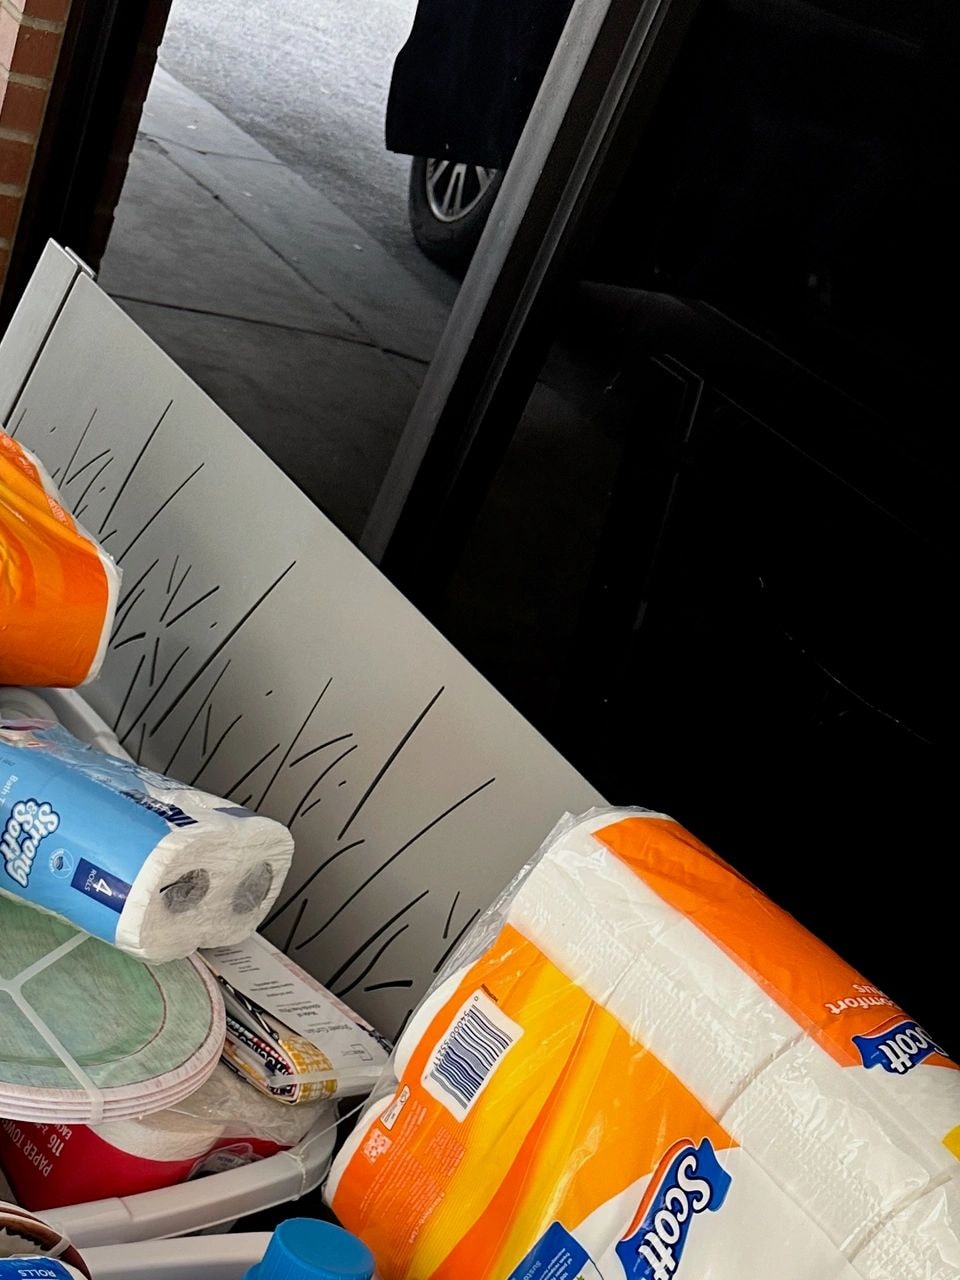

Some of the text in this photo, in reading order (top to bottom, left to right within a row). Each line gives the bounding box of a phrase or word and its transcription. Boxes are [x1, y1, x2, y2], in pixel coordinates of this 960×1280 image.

[0, 773, 19, 797] Bath
[23, 799, 41, 816] &
[1, 799, 67, 890] Strong
[82, 867, 97, 891] ROLLS
[90, 875, 116, 898] 4
[824, 997, 893, 1013] omfort
[20, 1141, 55, 1175] PAPER
[17, 1266, 55, 1278] ROLLS
